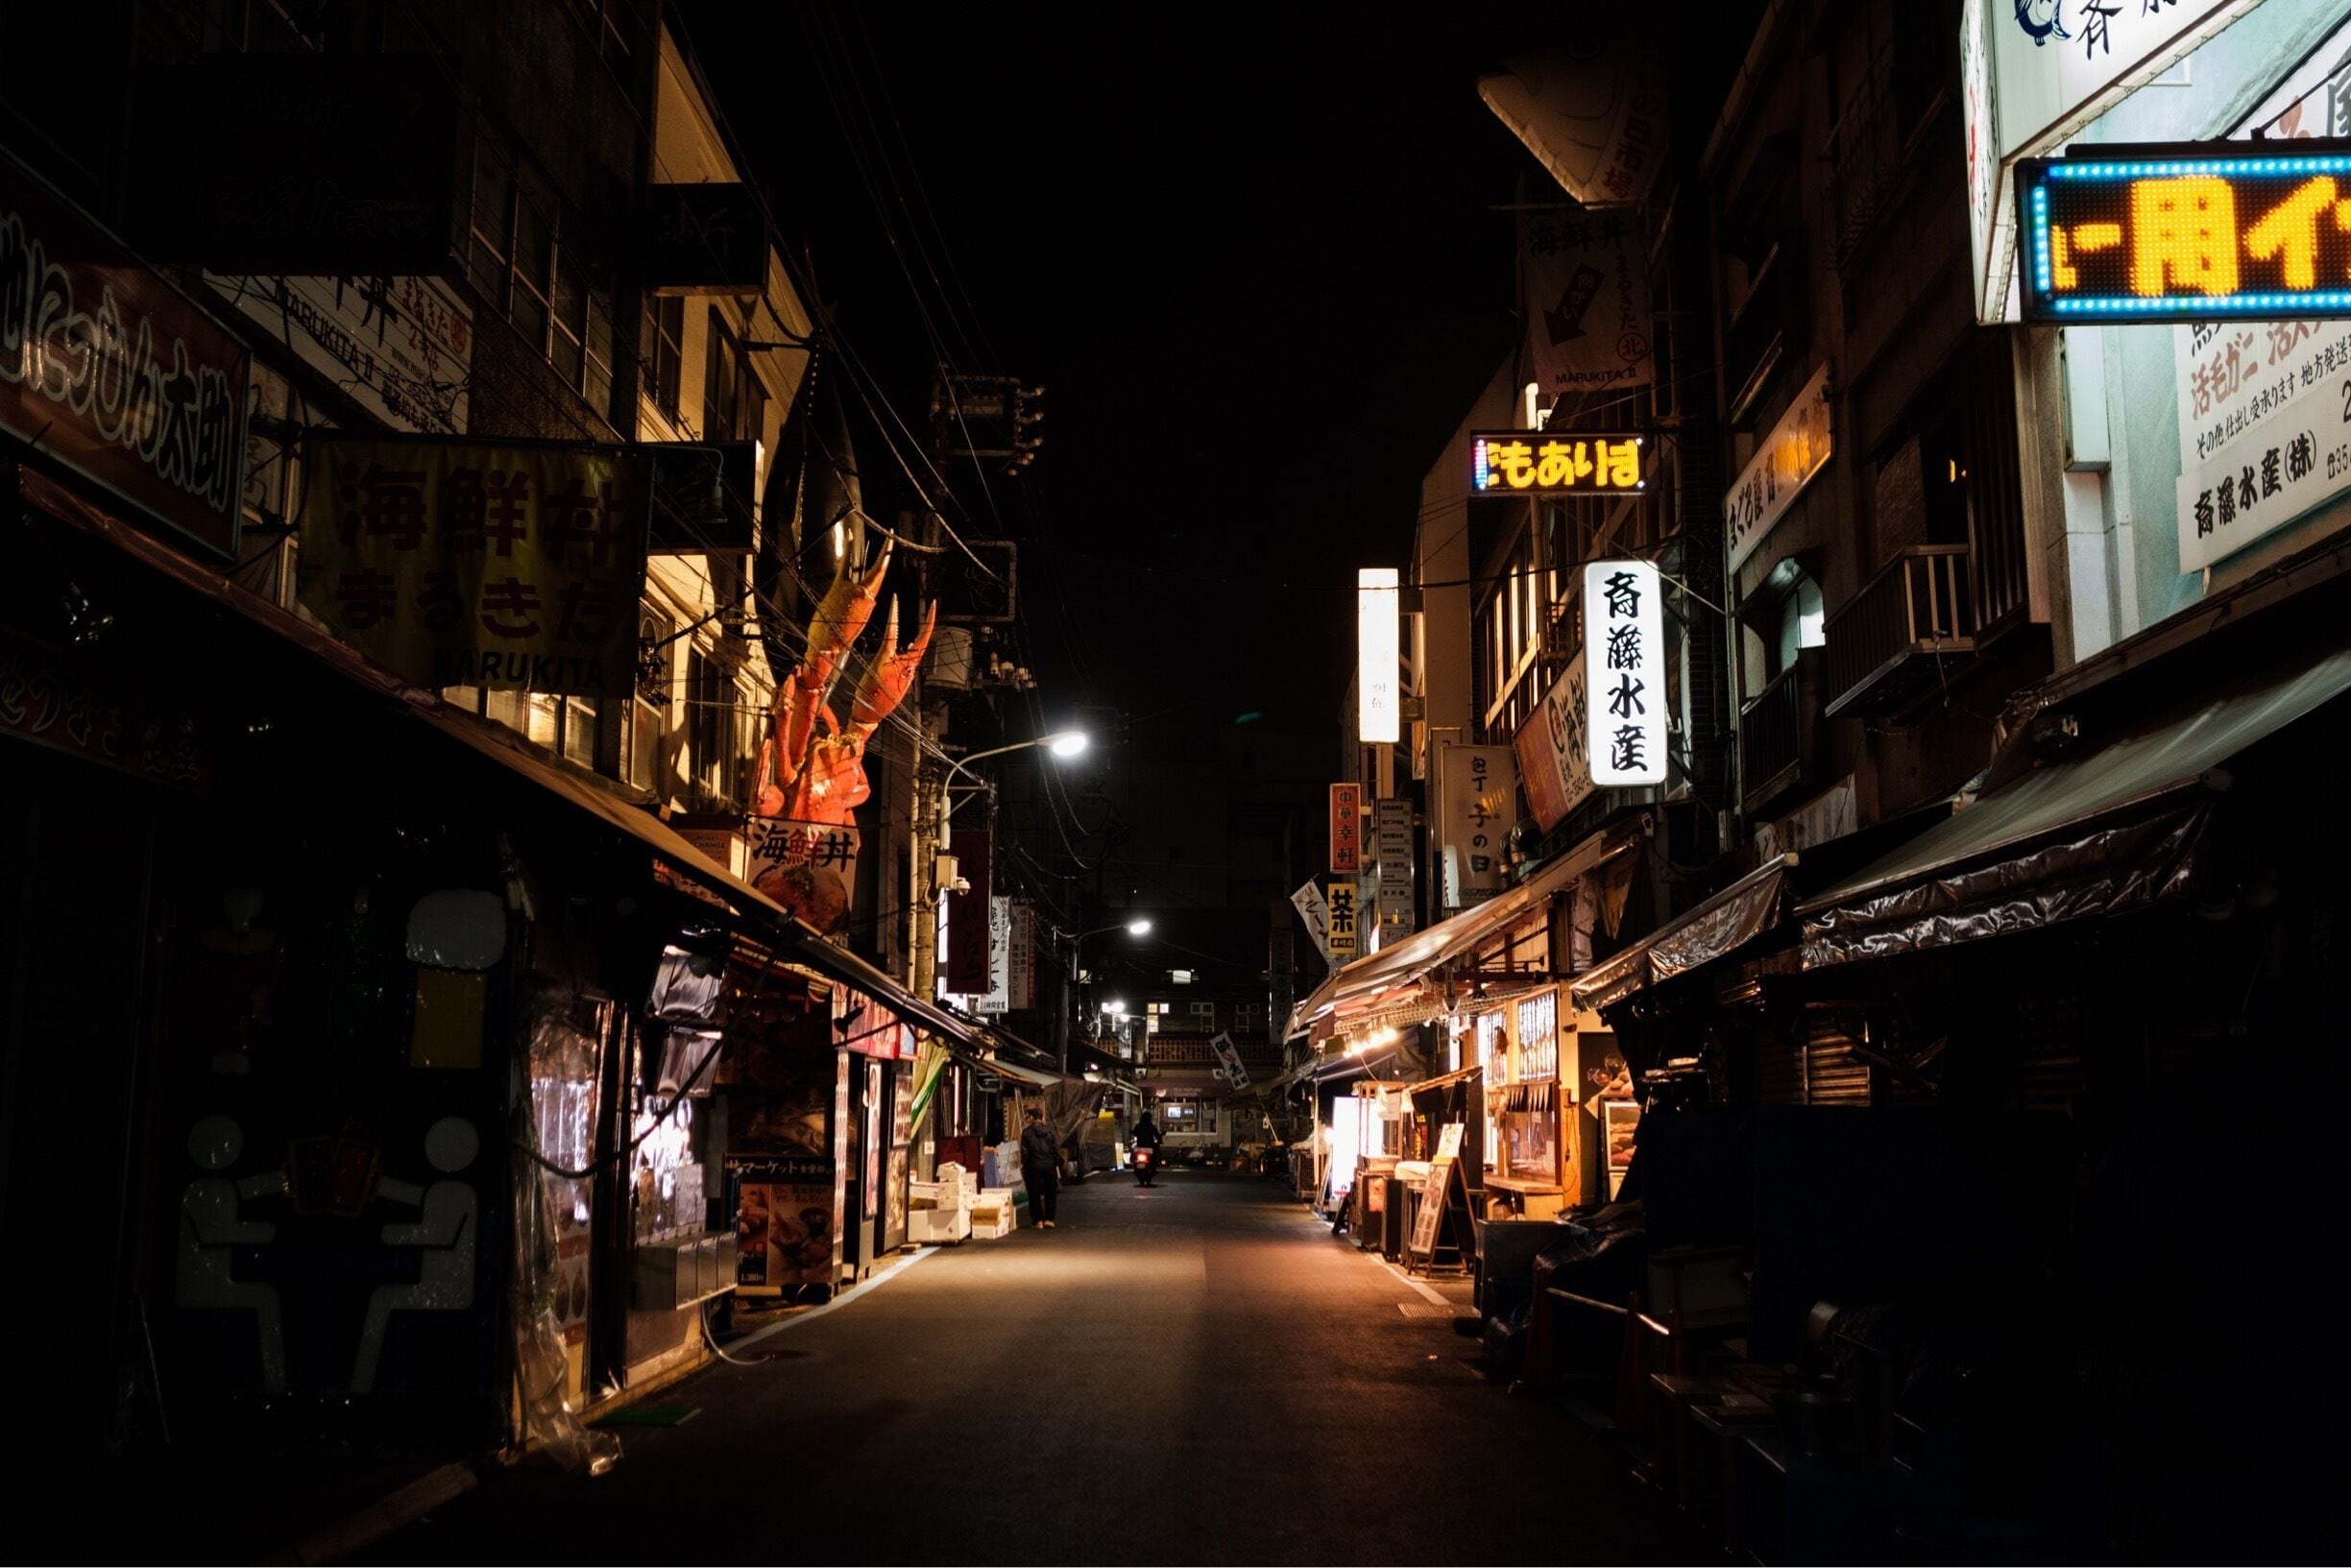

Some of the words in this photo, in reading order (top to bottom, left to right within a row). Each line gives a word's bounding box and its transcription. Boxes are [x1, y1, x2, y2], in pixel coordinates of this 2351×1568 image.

[1556, 372, 1622, 385] MARUKITA
[2191, 331, 2259, 422] 活毛ガニ
[339, 462, 624, 567] 海鮮丼
[335, 568, 616, 644] まるきた
[435, 646, 605, 687] MARUKITA
[752, 823, 855, 874] 海鮮丼
[1330, 889, 1353, 932] 茶
